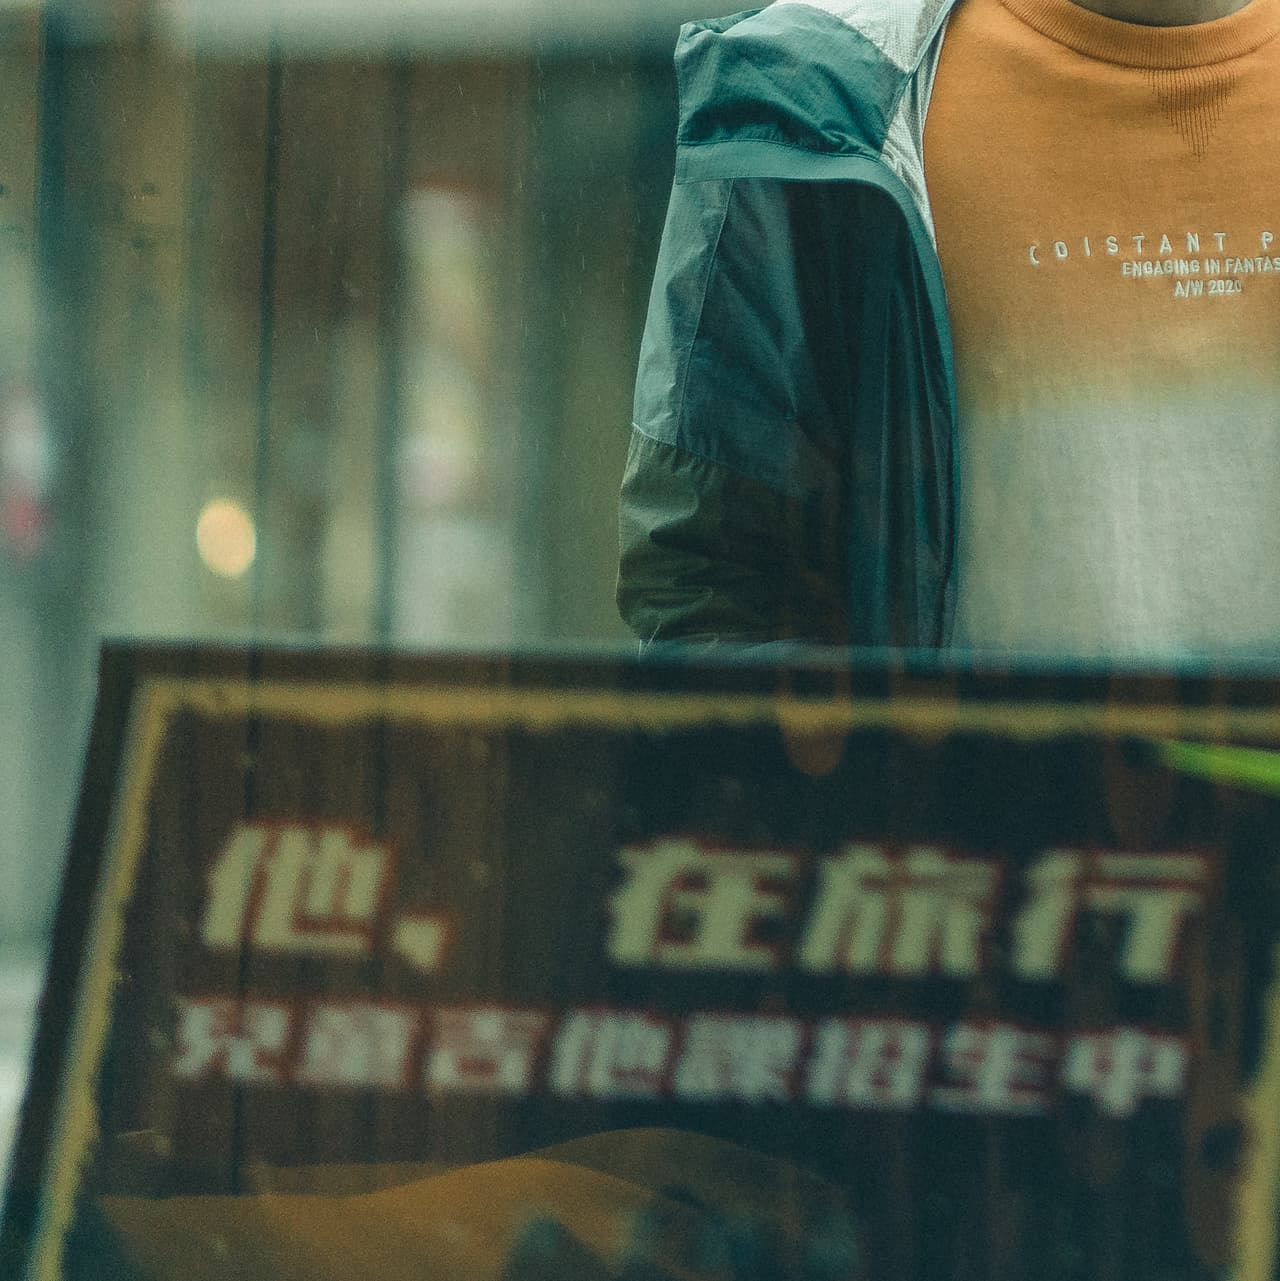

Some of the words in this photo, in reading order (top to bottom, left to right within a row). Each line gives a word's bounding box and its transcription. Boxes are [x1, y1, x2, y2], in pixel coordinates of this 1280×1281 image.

[1122, 258, 1200, 277] ENGAGING
[1204, 258, 1220, 275] IN
[1174, 280, 1204, 297] A/W
[1208, 279, 1242, 295] 2020
